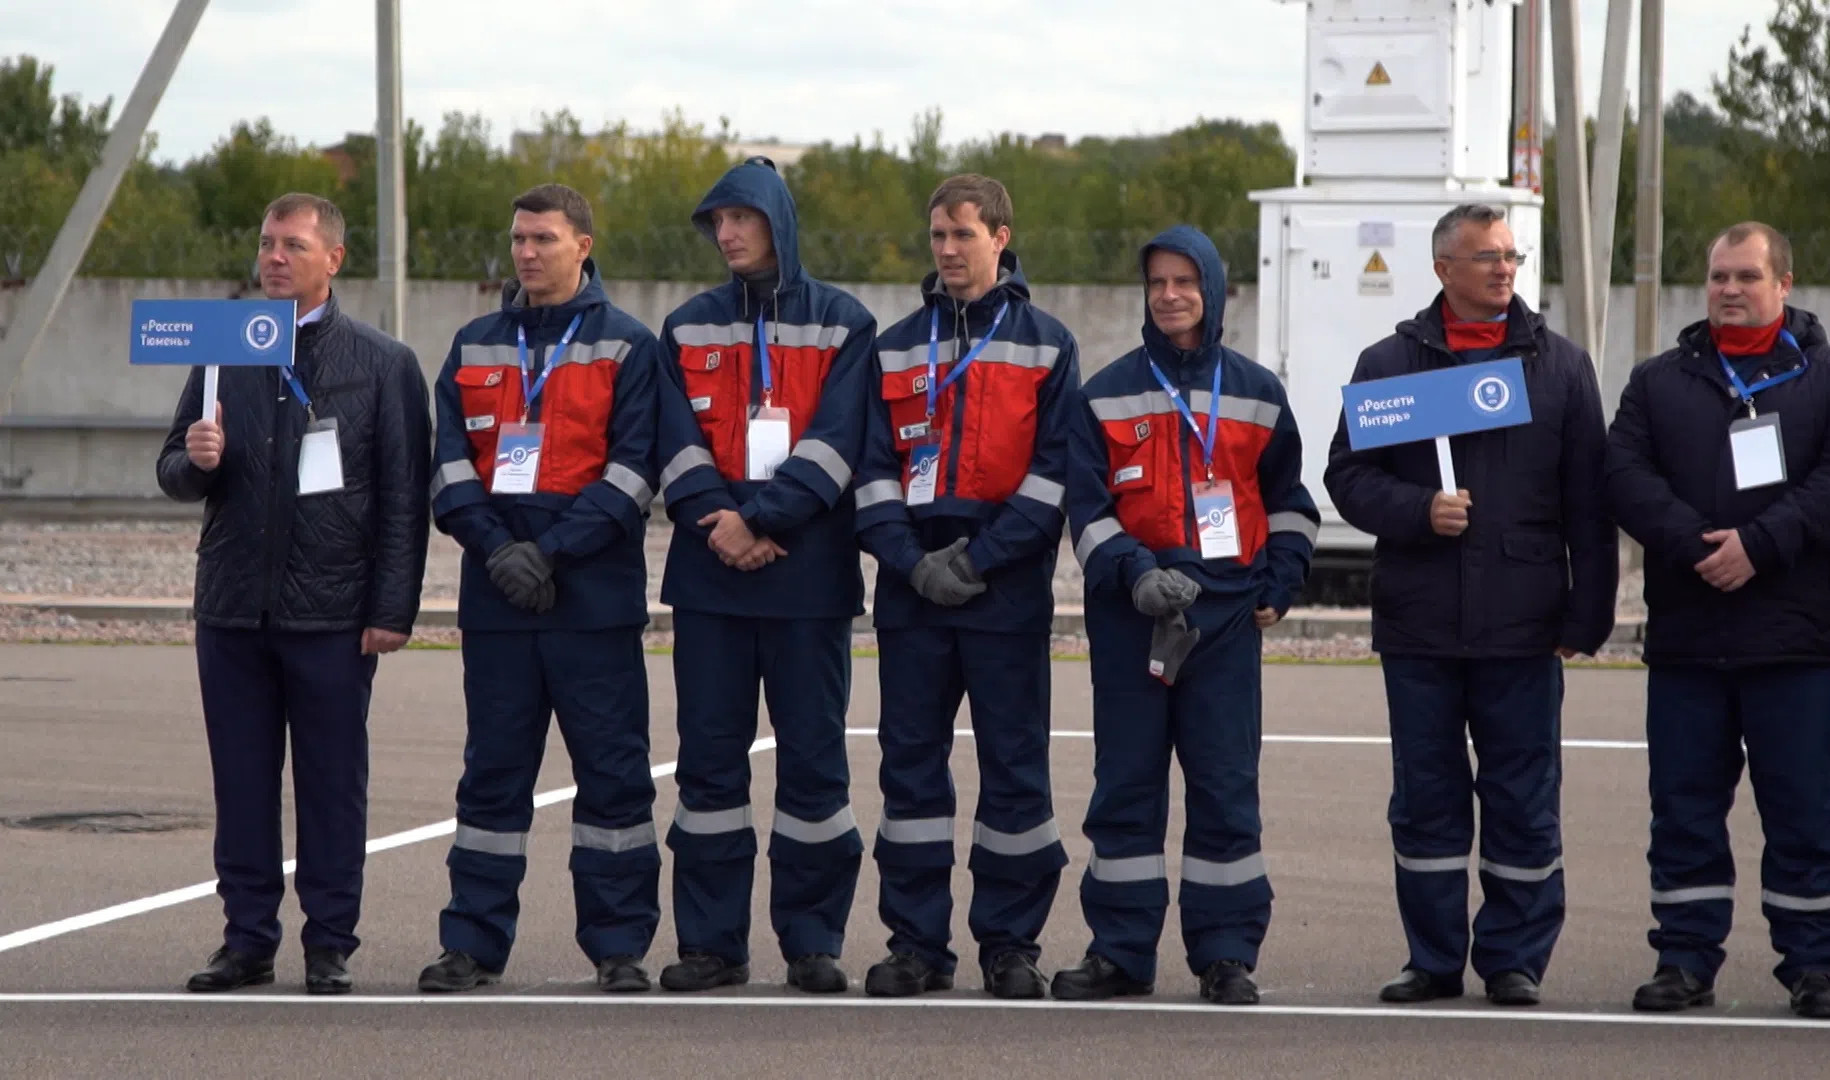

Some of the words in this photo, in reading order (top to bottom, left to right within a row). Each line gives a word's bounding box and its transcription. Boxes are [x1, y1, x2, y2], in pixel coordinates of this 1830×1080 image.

[141, 319, 194, 333] «Россети
[140, 334, 191, 347] Тюмень»
[1357, 395, 1415, 412] «Россети
[1359, 412, 1411, 428] Янтарь»
